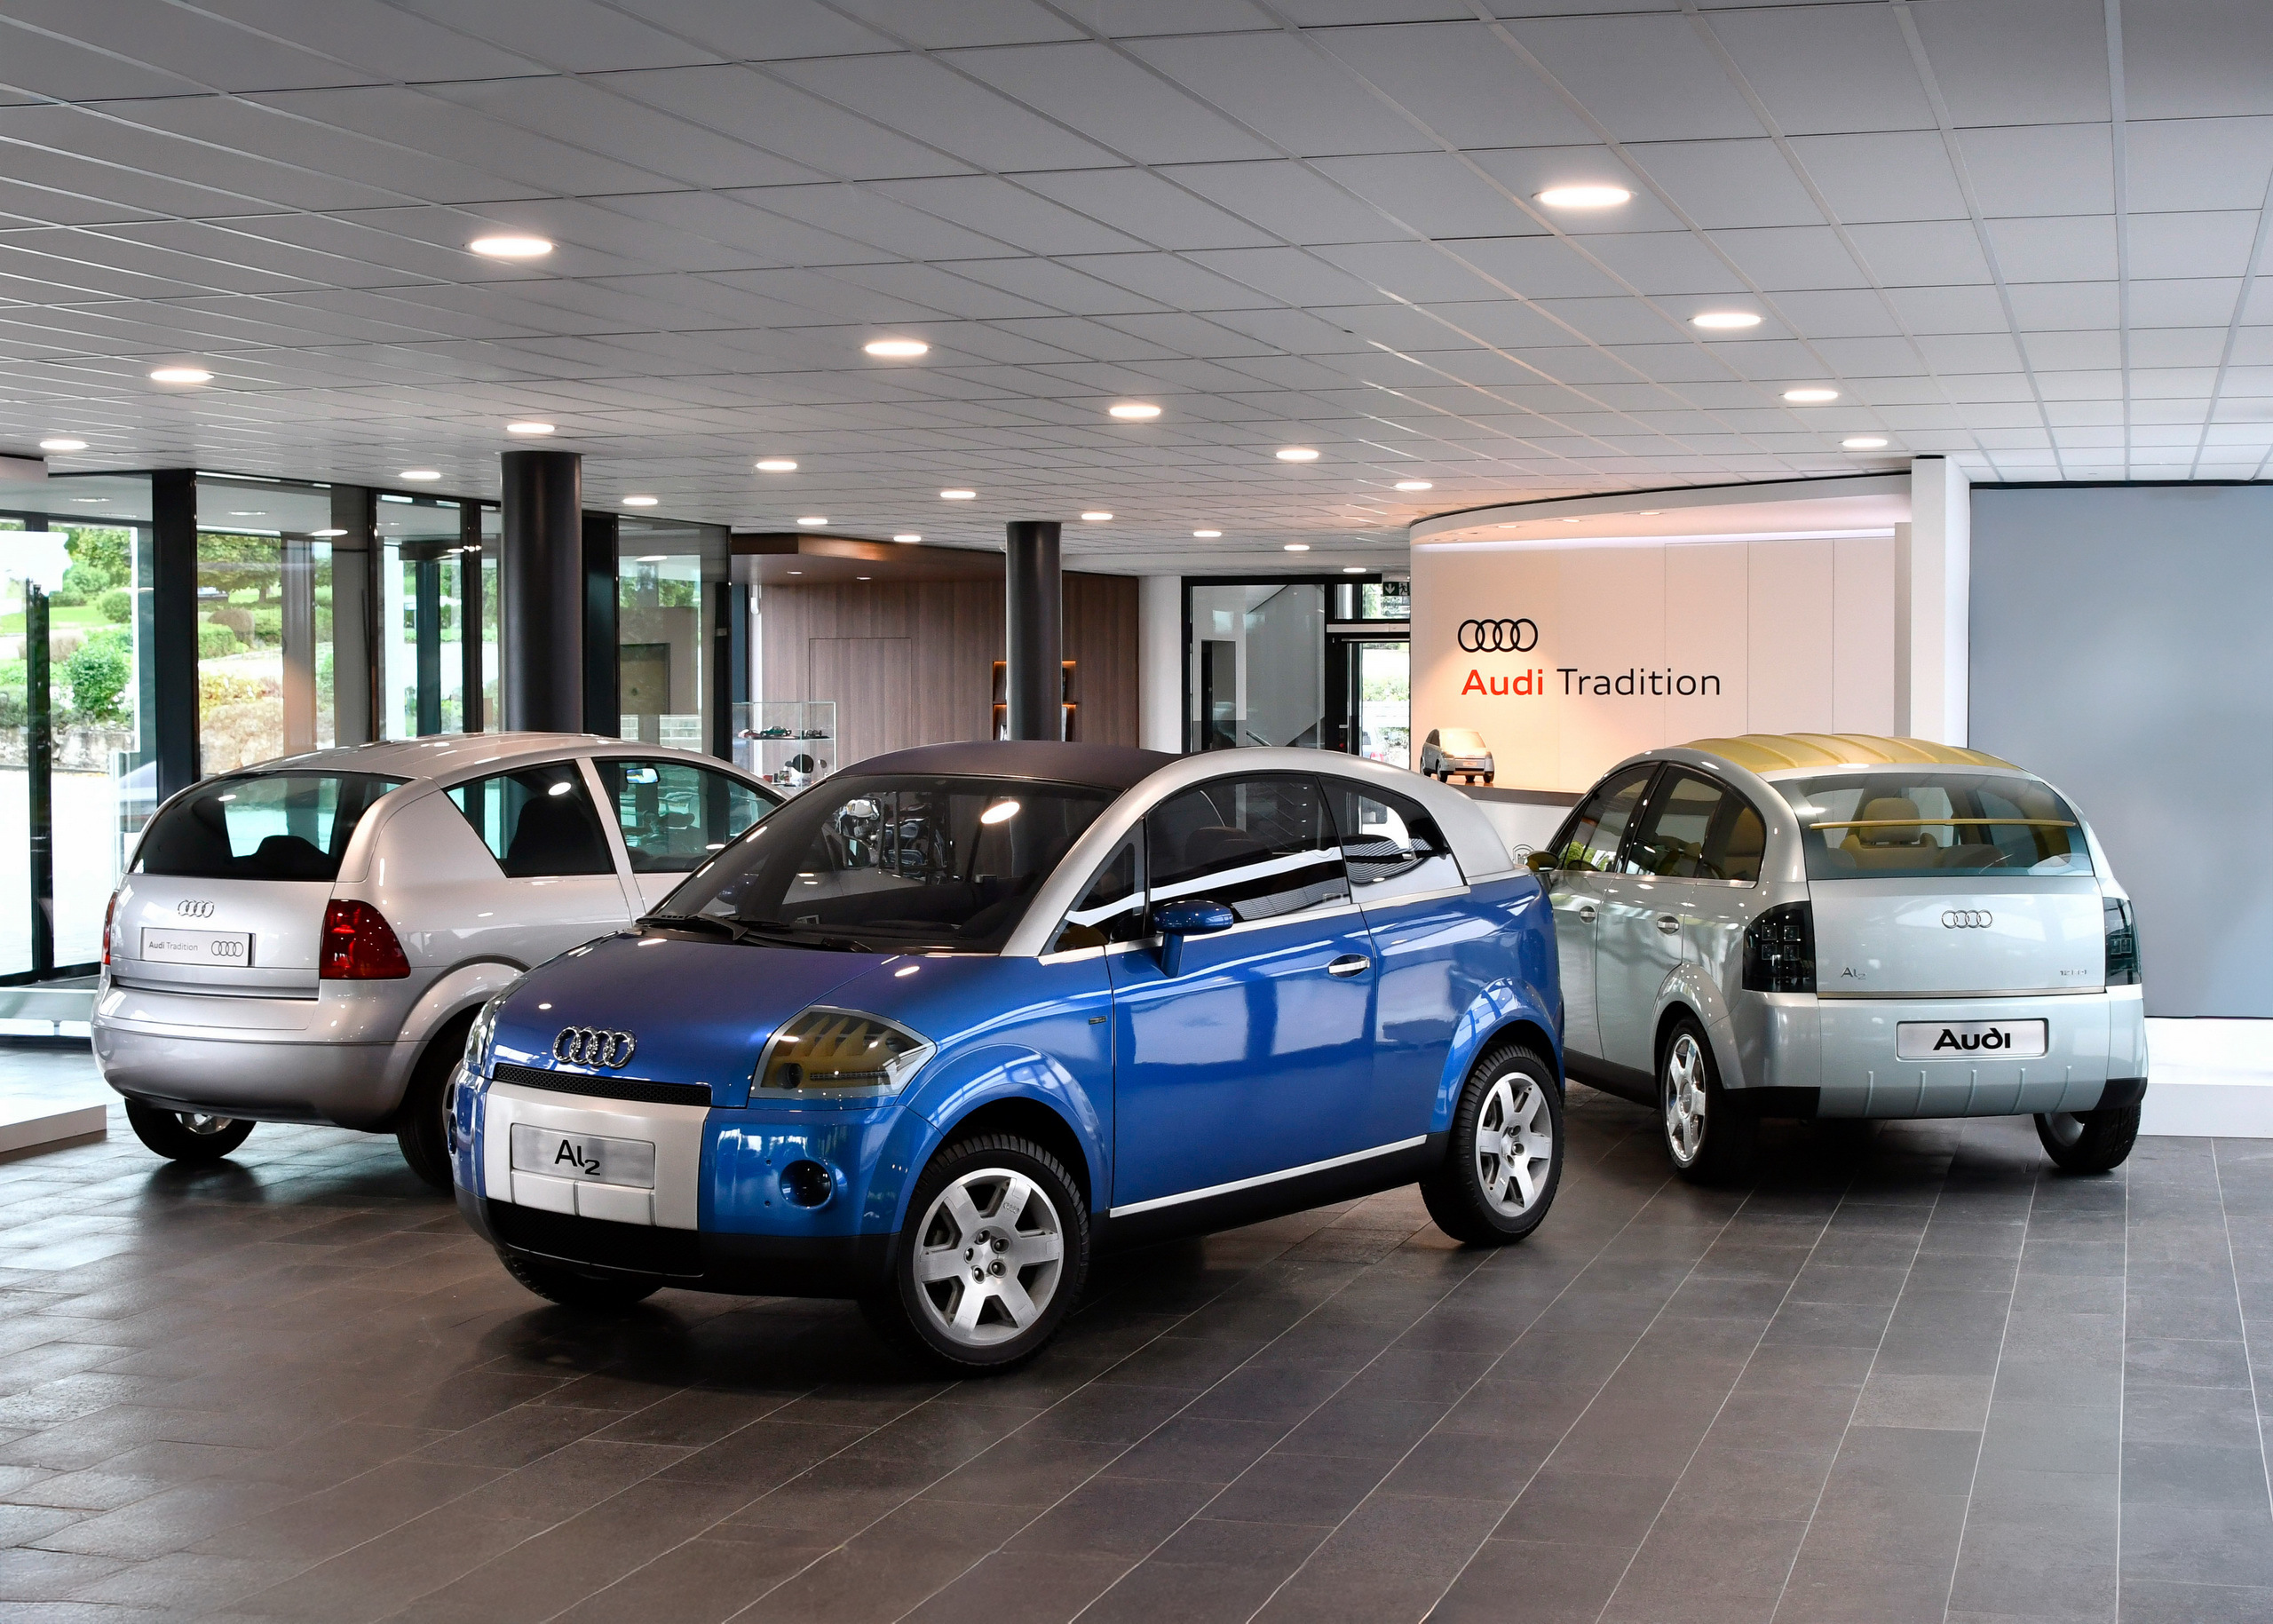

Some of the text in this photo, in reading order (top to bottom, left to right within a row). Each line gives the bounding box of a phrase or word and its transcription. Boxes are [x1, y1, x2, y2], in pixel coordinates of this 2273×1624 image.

[1461, 668, 1721, 696] Audi Tradition
[148, 941, 199, 952] Audi Tradition
[1932, 1027, 2011, 1051] Audi
